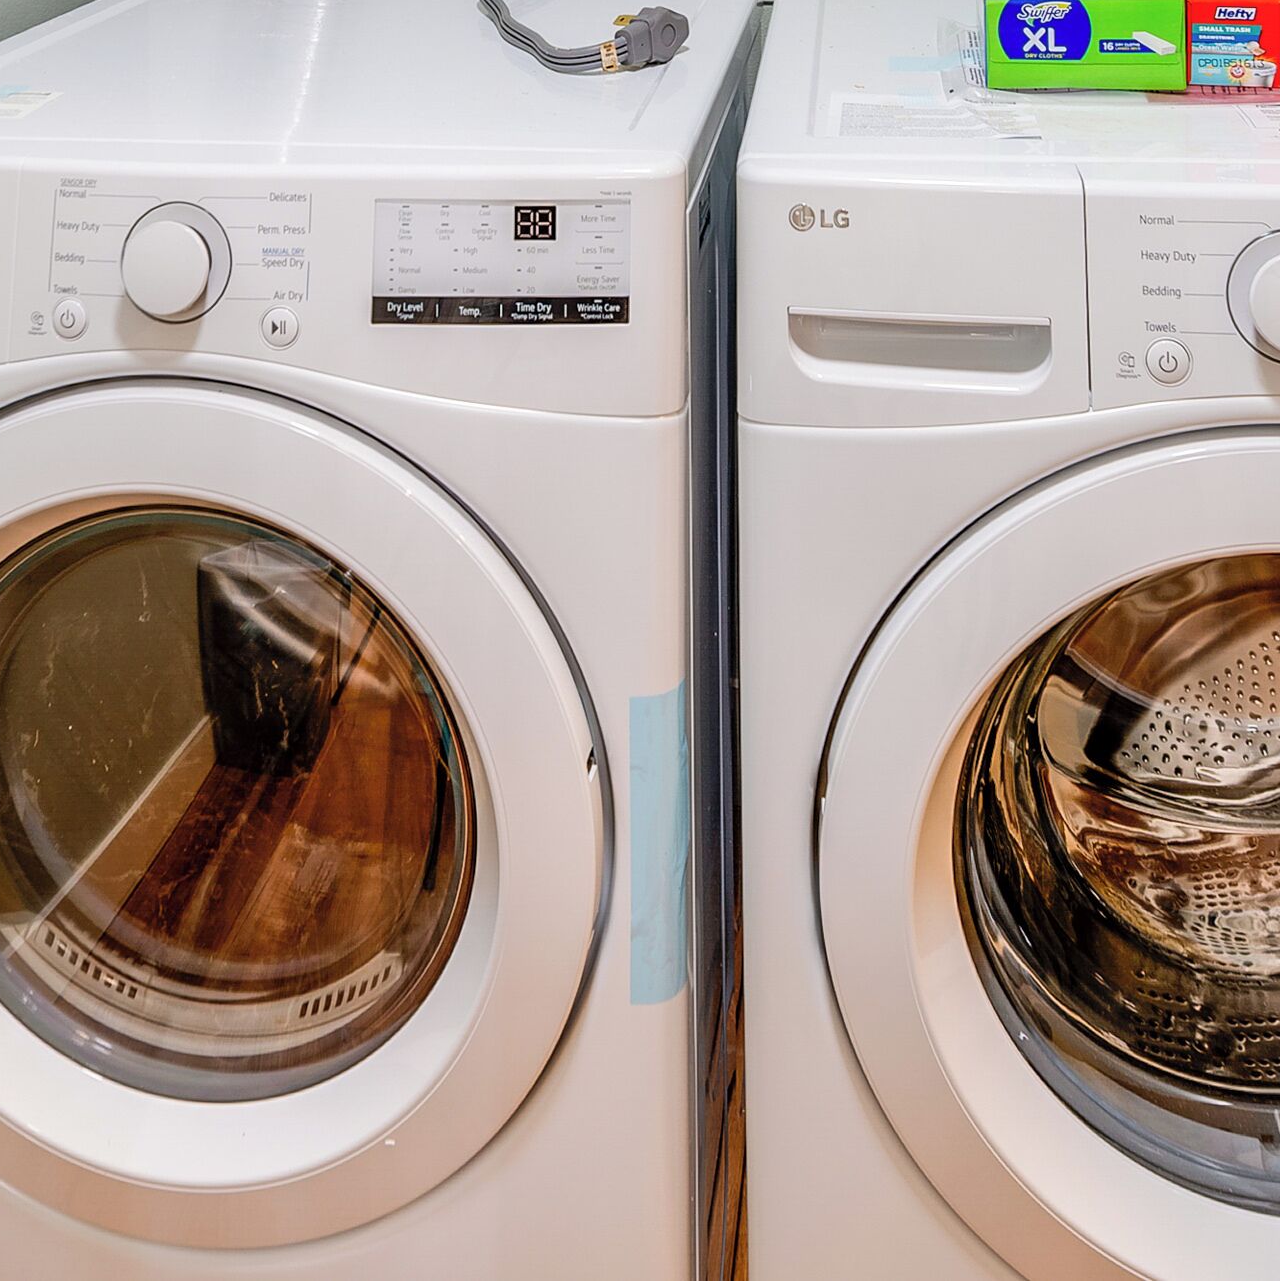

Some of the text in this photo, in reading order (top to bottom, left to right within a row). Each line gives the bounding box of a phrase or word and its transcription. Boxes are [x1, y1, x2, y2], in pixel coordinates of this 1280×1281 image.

[1017, 2, 1072, 23] Swiffer
[1217, 8, 1254, 19] Hefty
[1023, 27, 1067, 52] XL
[1103, 42, 1114, 50] 16
[59, 190, 86, 198] Normal
[269, 192, 307, 202] Delicates
[820, 208, 850, 229] LG
[1139, 215, 1175, 226] Normal
[57, 220, 100, 233] Heavy Duty
[258, 225, 305, 234] Perm. Press
[400, 247, 413, 255] Very
[464, 247, 478, 255] High
[1140, 250, 1197, 263] Heavy Duty
[54, 252, 85, 265] Bedding
[262, 258, 304, 269] Speed Dry
[577, 275, 620, 284] Energy Saver
[53, 285, 78, 295] Towels
[1142, 285, 1182, 299] Bedding
[273, 291, 303, 302] Air Dry
[387, 302, 424, 313] Dry Level
[459, 306, 481, 318] Temp.
[516, 302, 552, 313] Time Dry
[577, 304, 620, 312] Wrinkle Care
[1144, 322, 1177, 333] Towels
